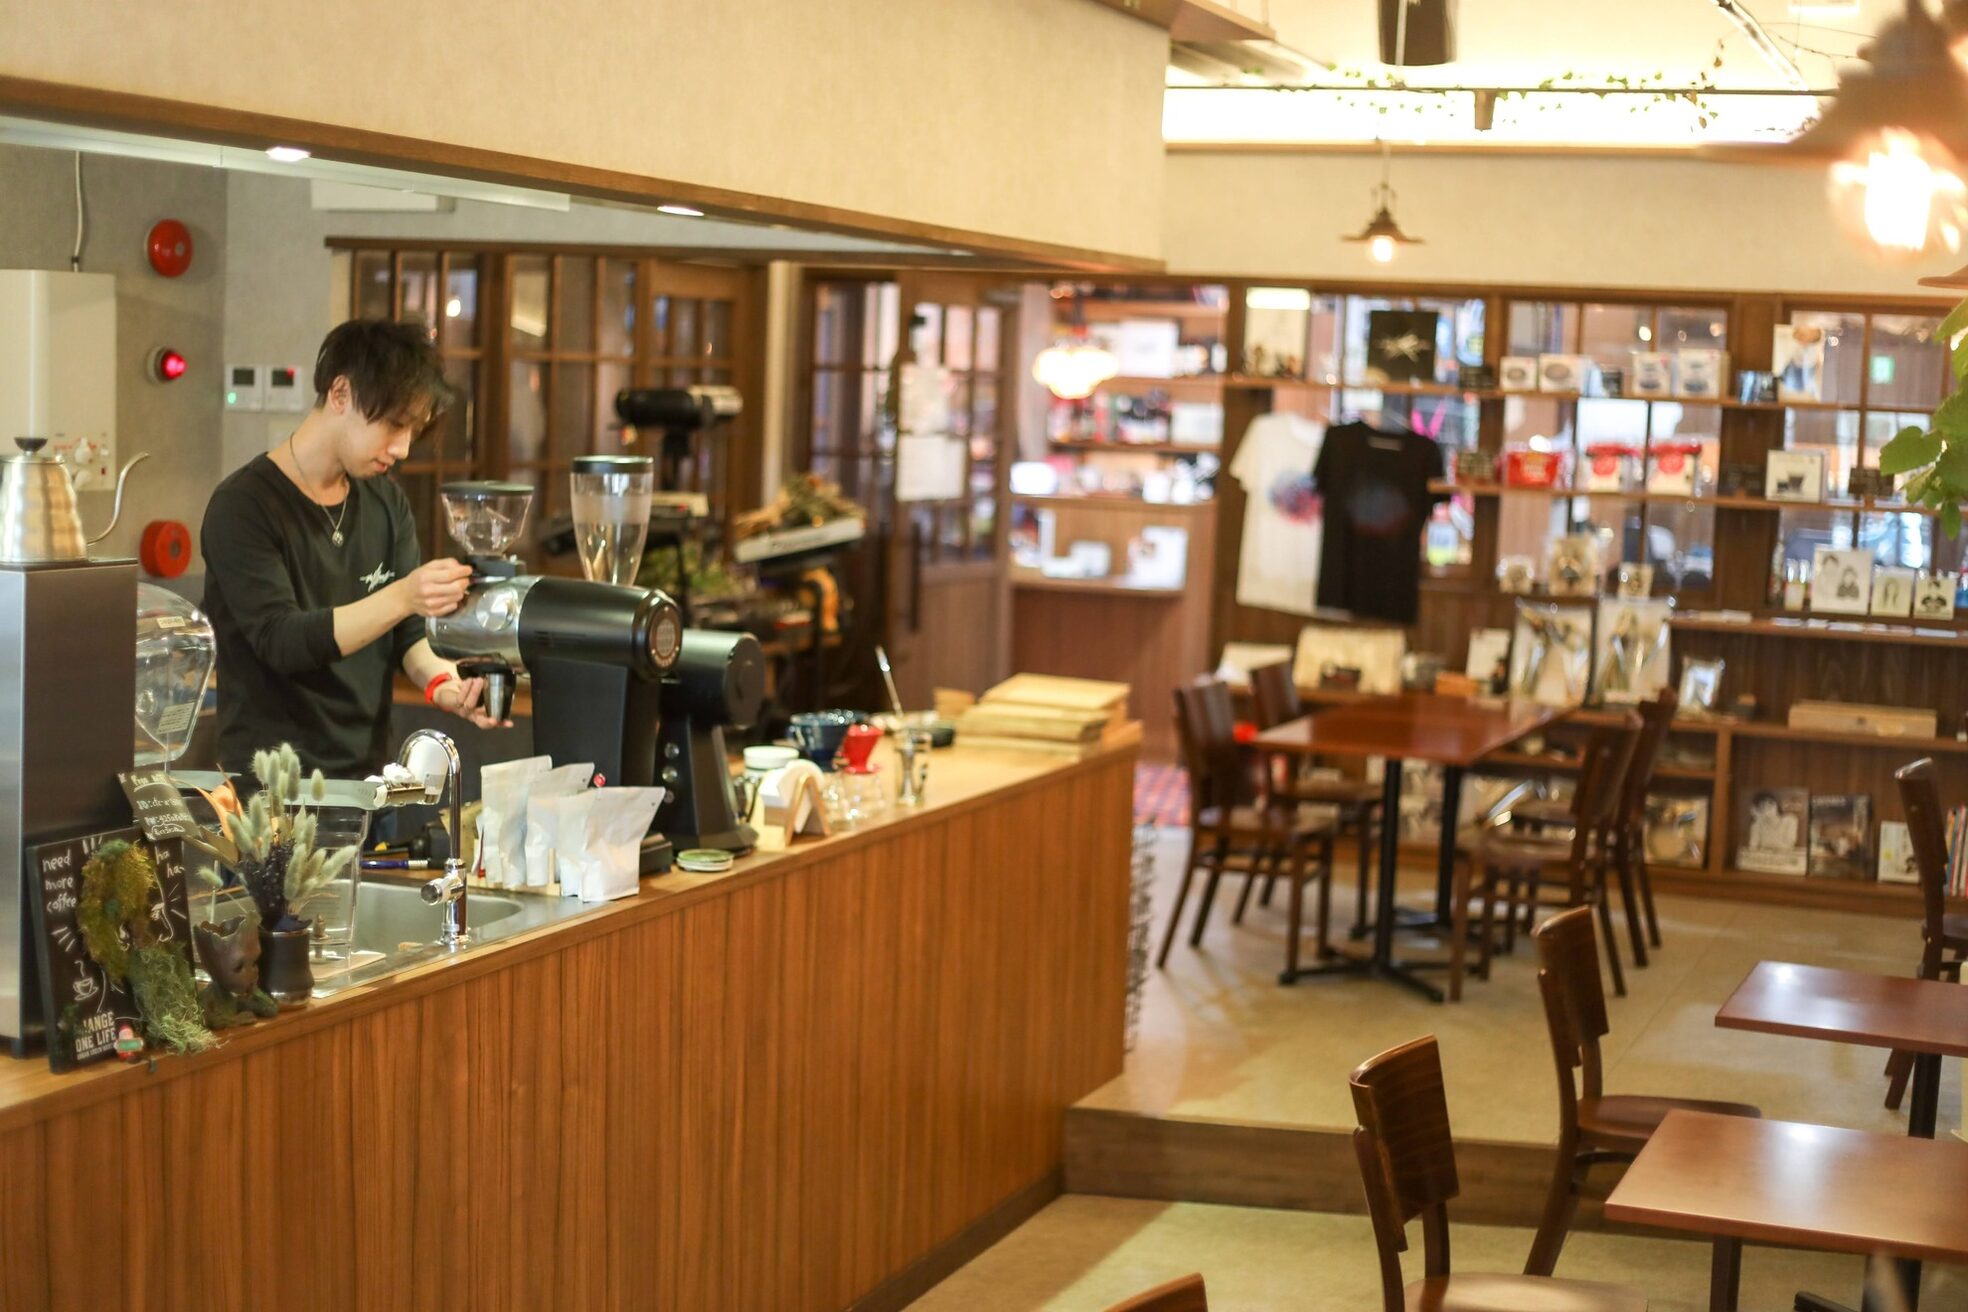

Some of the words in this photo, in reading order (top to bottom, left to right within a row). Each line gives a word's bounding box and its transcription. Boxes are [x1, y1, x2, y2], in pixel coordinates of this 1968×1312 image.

[42, 848, 72, 873] need
[45, 876, 74, 891] more
[46, 892, 77, 913] coffee
[75, 1036, 94, 1053] ONE
[96, 1027, 117, 1046] LIFE
